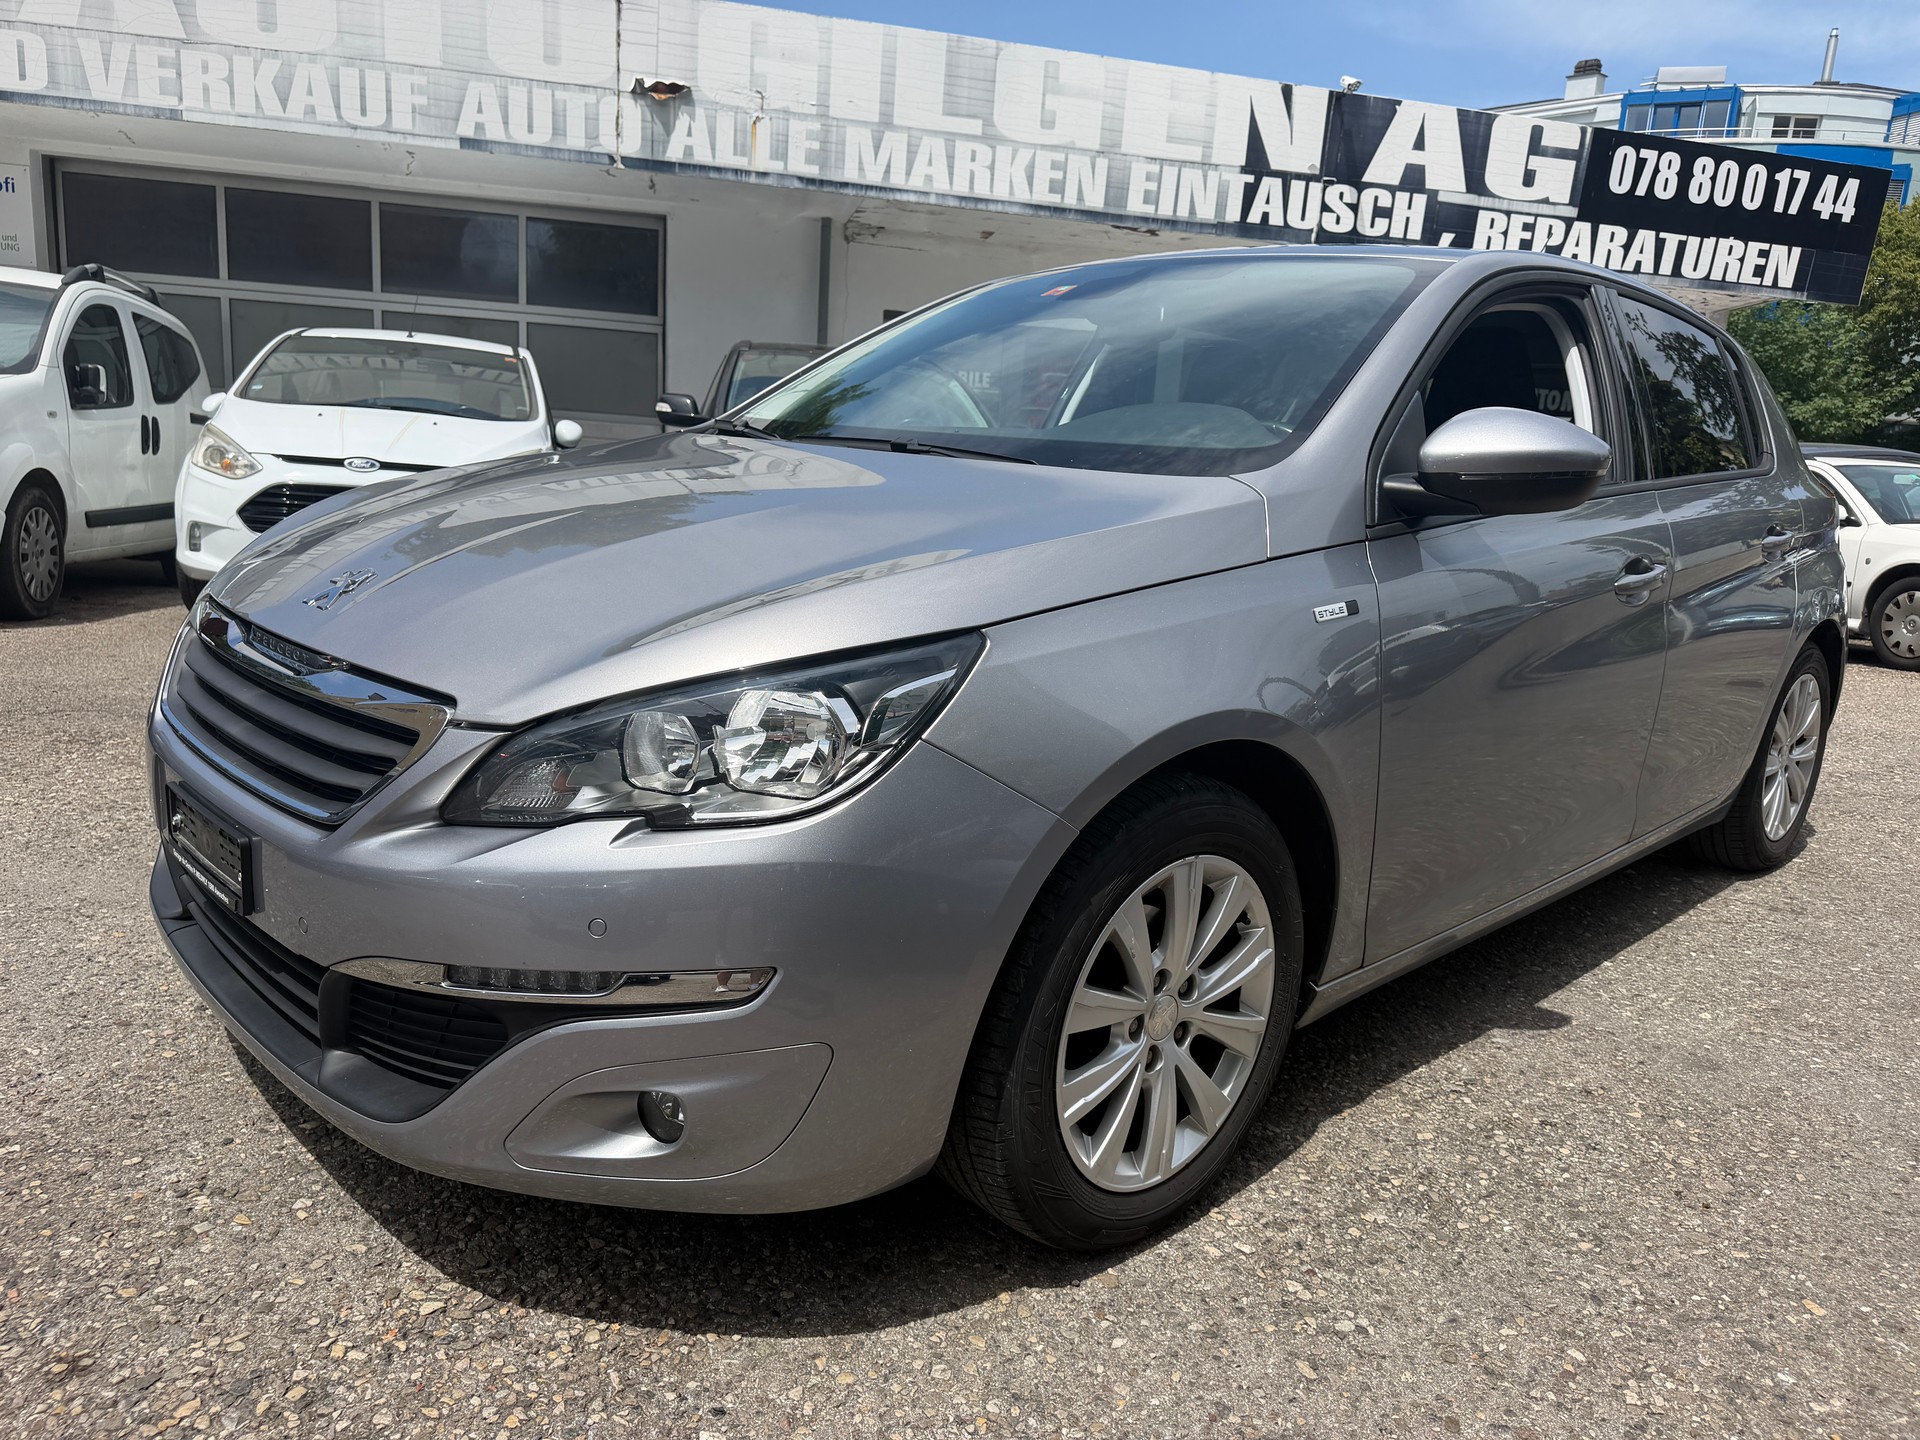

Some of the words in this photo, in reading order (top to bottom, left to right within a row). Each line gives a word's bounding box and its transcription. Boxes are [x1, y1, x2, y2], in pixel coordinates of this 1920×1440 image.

[16, 0, 616, 84] TO
[697, 6, 1329, 174] GILGEN
[1361, 99, 1582, 204] AG
[77, 37, 428, 130] VERKAUF
[456, 80, 641, 154] AUTO
[665, 106, 821, 174] ALLE
[843, 123, 1108, 208] MARKEN
[1126, 160, 1428, 241] EINTAUSCH
[1471, 209, 1802, 289] REPARATUREN
[1608, 145, 1682, 200] 078
[1774, 167, 1811, 215] 17
[1812, 174, 1861, 223] 44
[2, 233, 17, 242] und
[1317, 606, 1345, 619] STYLE
